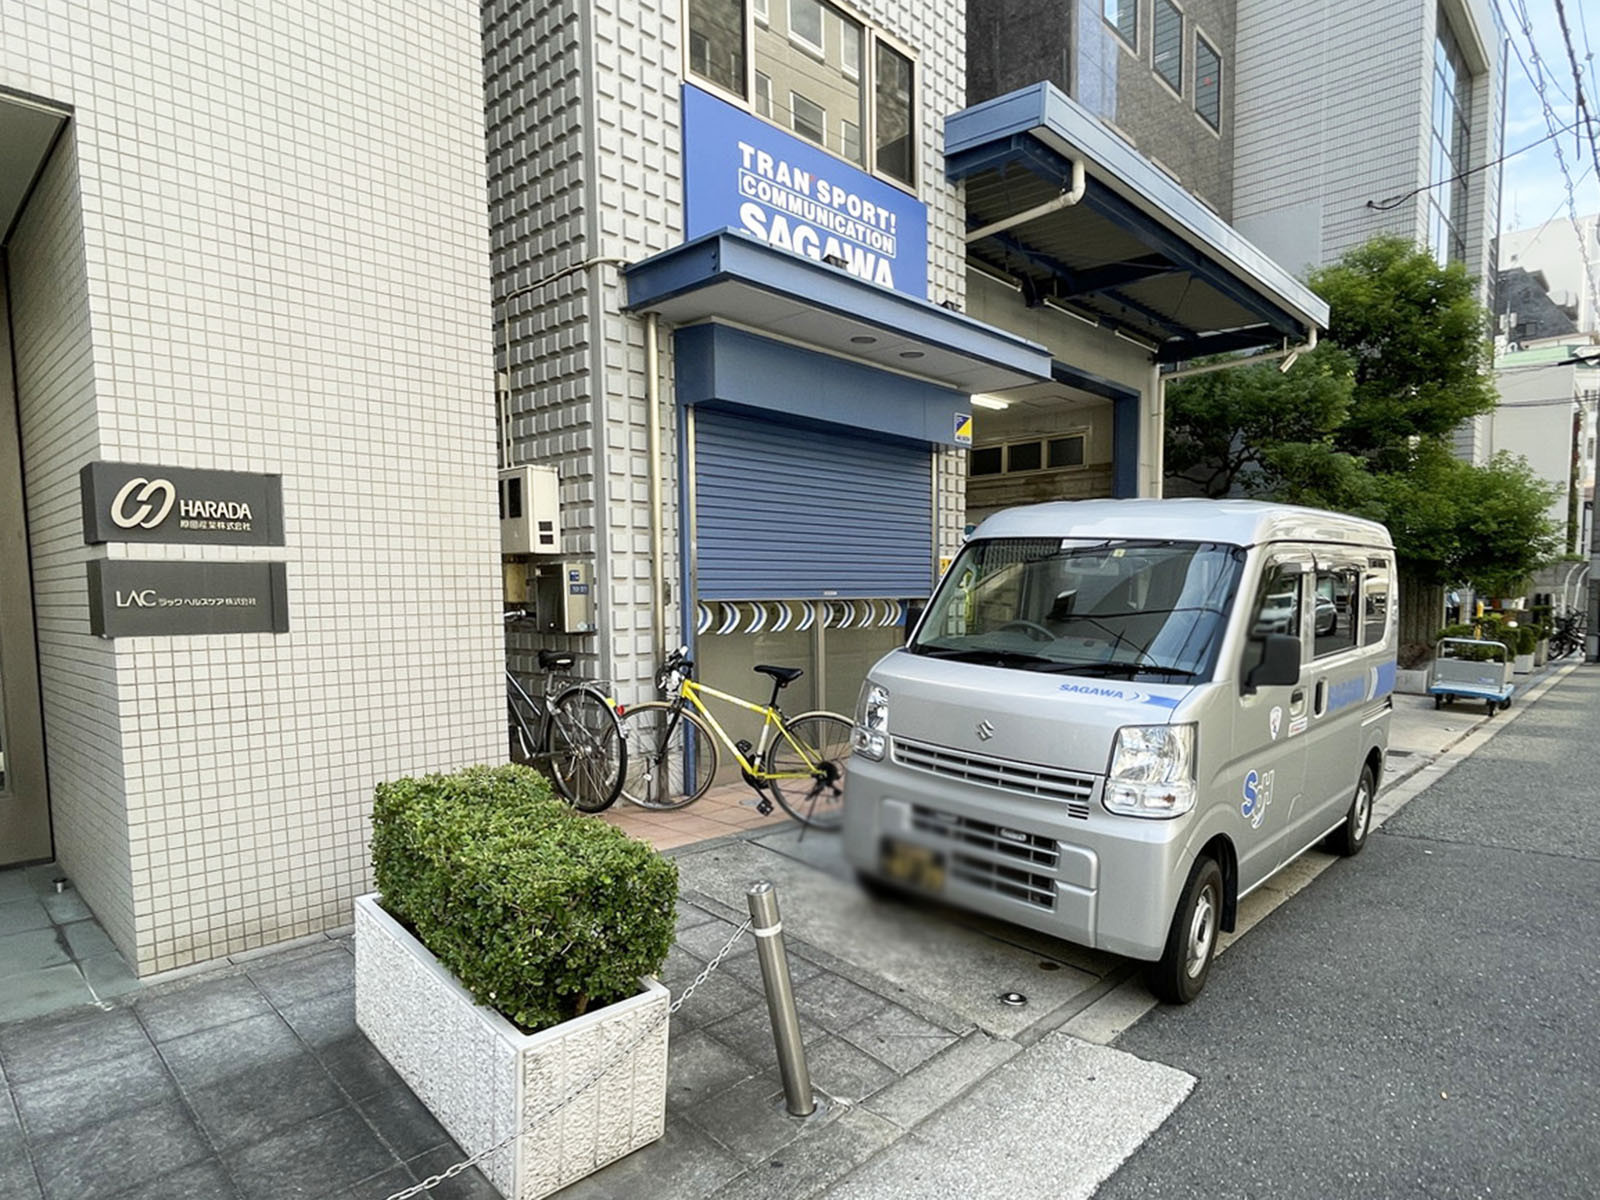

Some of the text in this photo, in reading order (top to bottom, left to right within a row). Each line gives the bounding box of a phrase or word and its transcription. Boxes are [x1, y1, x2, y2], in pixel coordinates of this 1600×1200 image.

[742, 174, 893, 254] COMMUNICATION
[739, 201, 895, 290] SAGAWA
[180, 499, 253, 520] HARADA
[115, 589, 157, 608] LAC
[1059, 683, 1124, 699] SAGAWA
